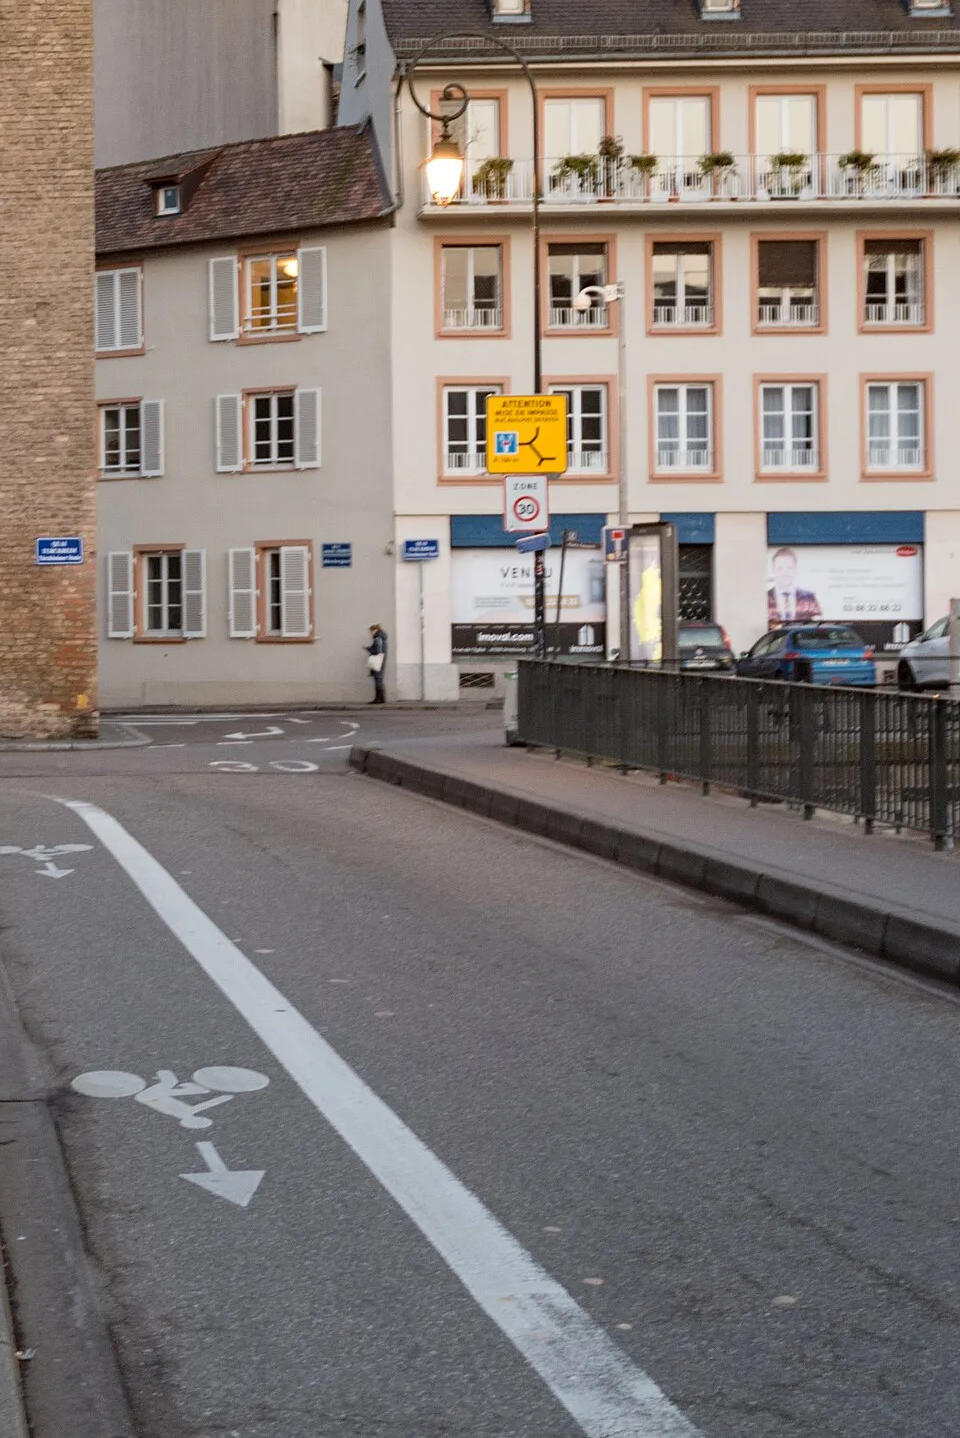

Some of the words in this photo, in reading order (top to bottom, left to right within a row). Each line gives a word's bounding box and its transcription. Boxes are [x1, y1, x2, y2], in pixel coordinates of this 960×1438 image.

[502, 399, 552, 408] ATTENTION
[513, 482, 538, 491] ZONE
[518, 504, 535, 515] 30
[500, 566, 553, 578] VENU
